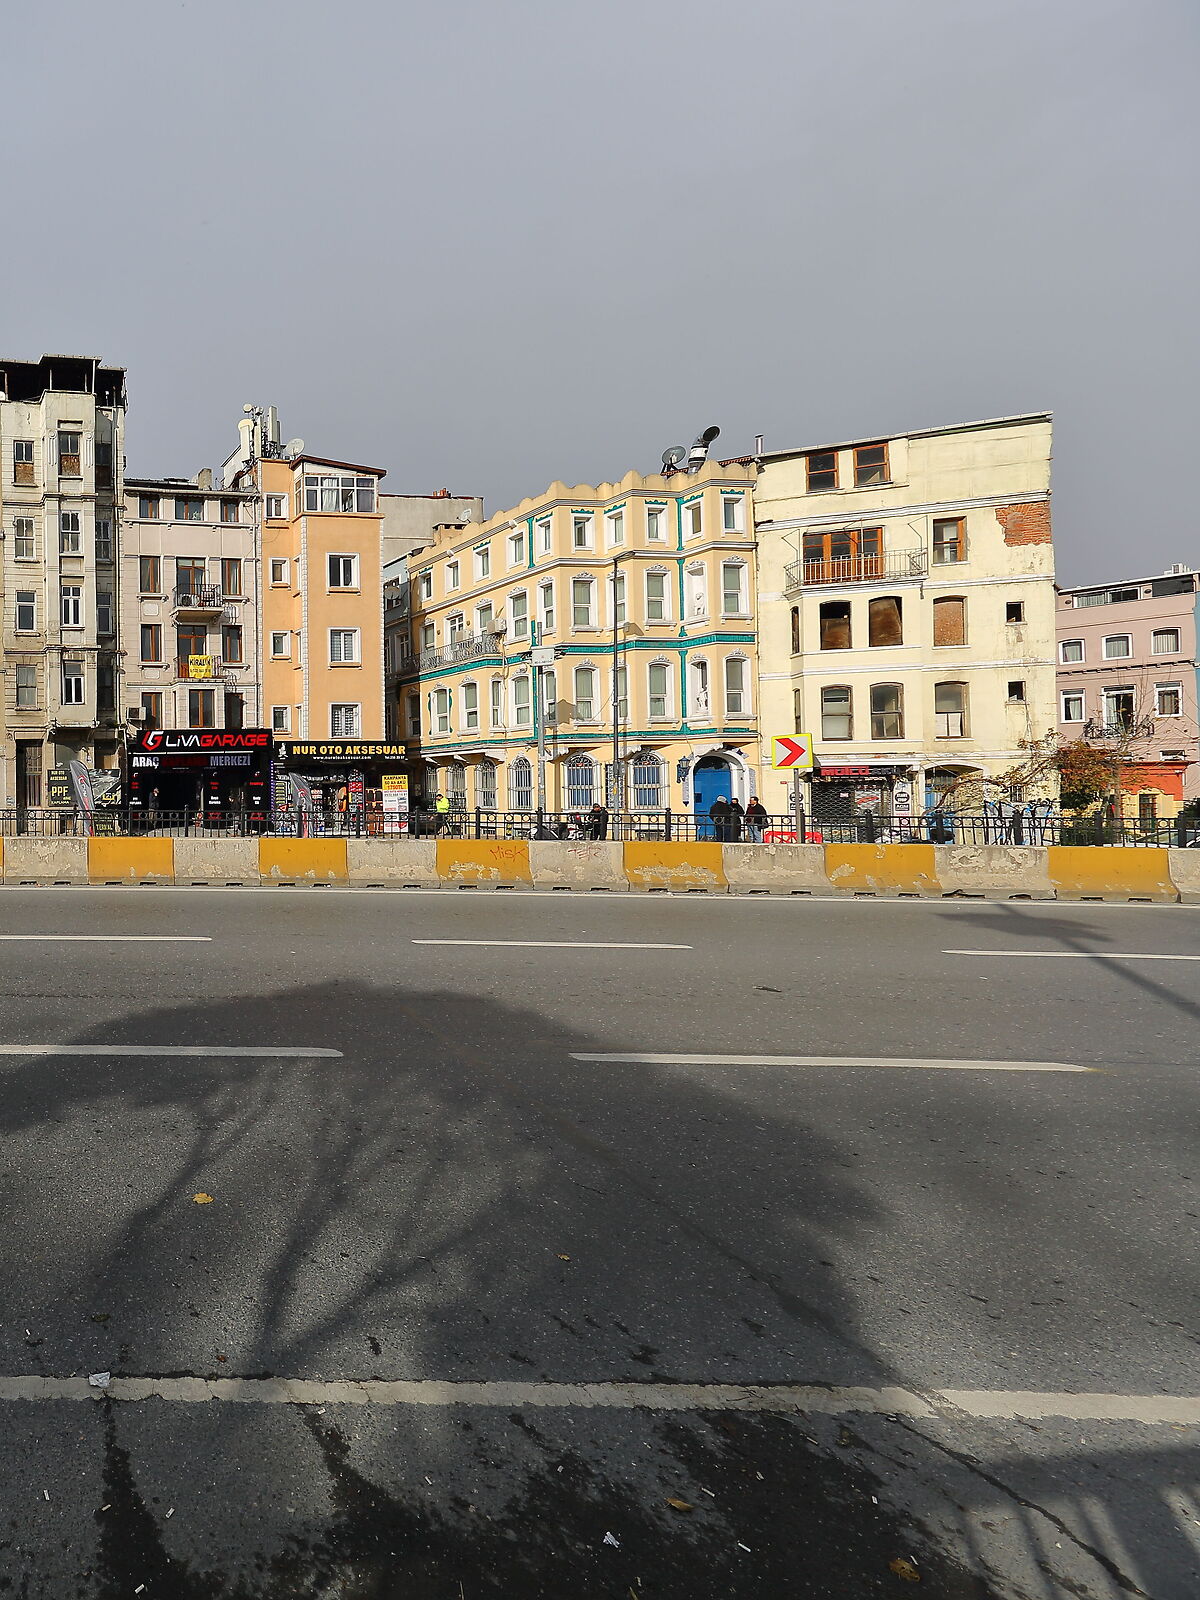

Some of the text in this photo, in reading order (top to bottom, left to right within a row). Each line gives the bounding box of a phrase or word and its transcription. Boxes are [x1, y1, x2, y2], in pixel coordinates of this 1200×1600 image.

[292, 746, 406, 754] NUR OTO AKSESUAR
[132, 756, 160, 769] ARAÇ
[210, 754, 250, 766] MERKEZİ
[52, 786, 68, 796] PPF
